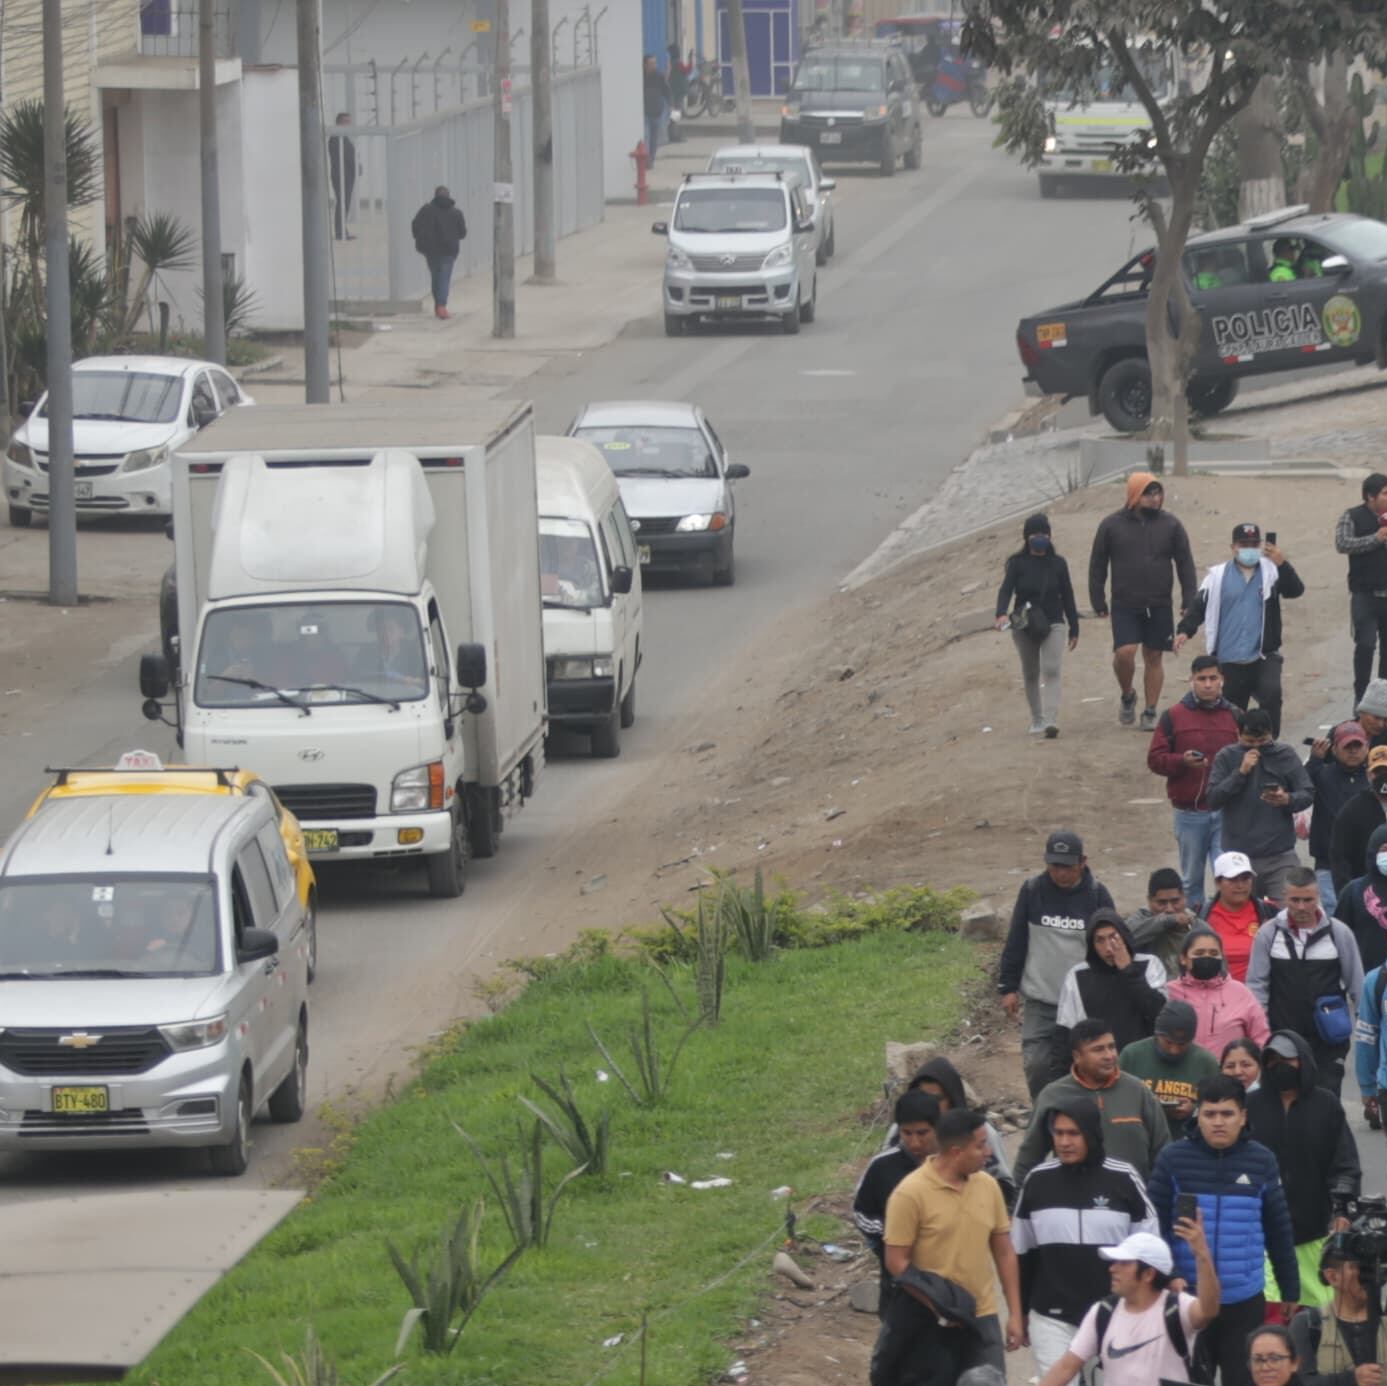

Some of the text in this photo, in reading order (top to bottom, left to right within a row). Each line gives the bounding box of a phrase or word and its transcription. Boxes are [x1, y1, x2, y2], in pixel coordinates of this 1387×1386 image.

[1213, 303, 1321, 345] POLICIA
[1041, 914, 1085, 930] adidas
[1155, 1080, 1199, 1100] ANGEL
[55, 1093, 106, 1110] BTY-480
